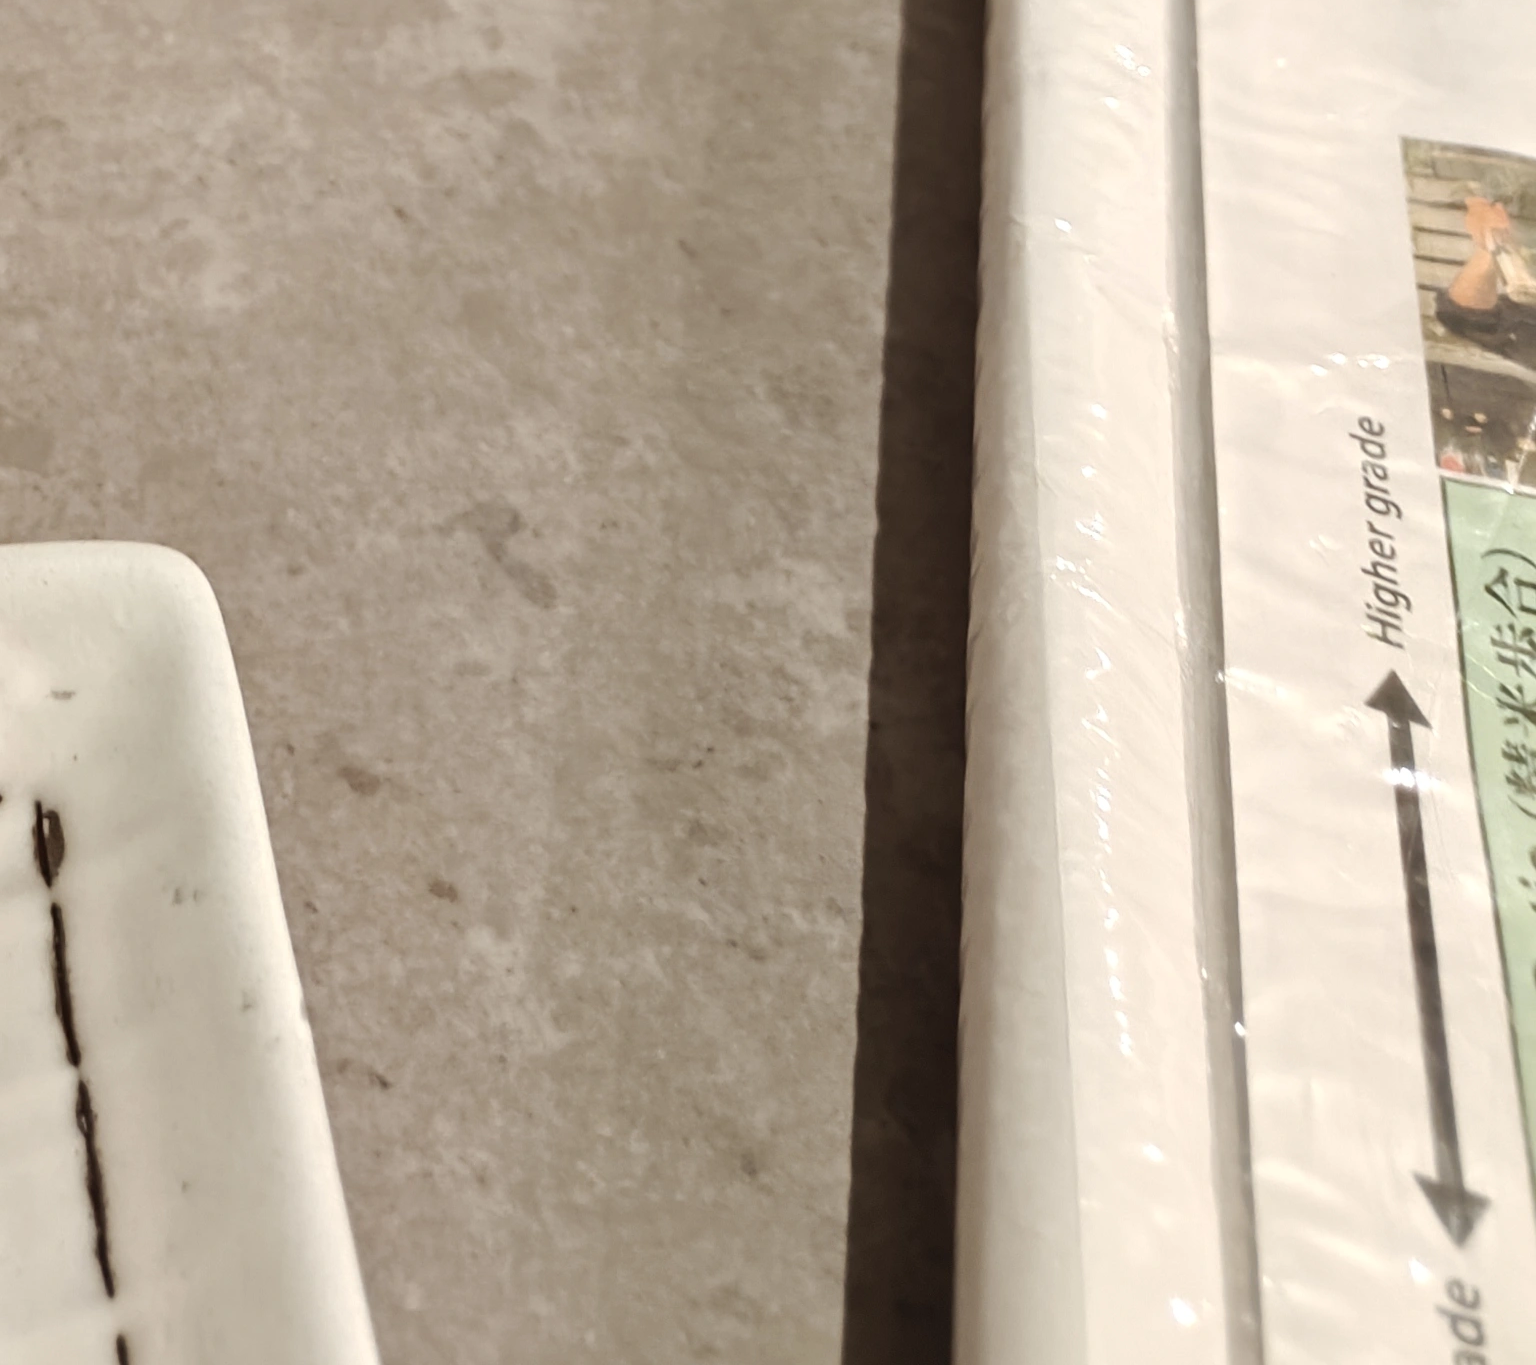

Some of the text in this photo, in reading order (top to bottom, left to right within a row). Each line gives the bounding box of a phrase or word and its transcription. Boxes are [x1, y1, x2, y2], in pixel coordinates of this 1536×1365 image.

[1348, 414, 1413, 650] Higher grade
[1435, 1277, 1485, 1365] ade
